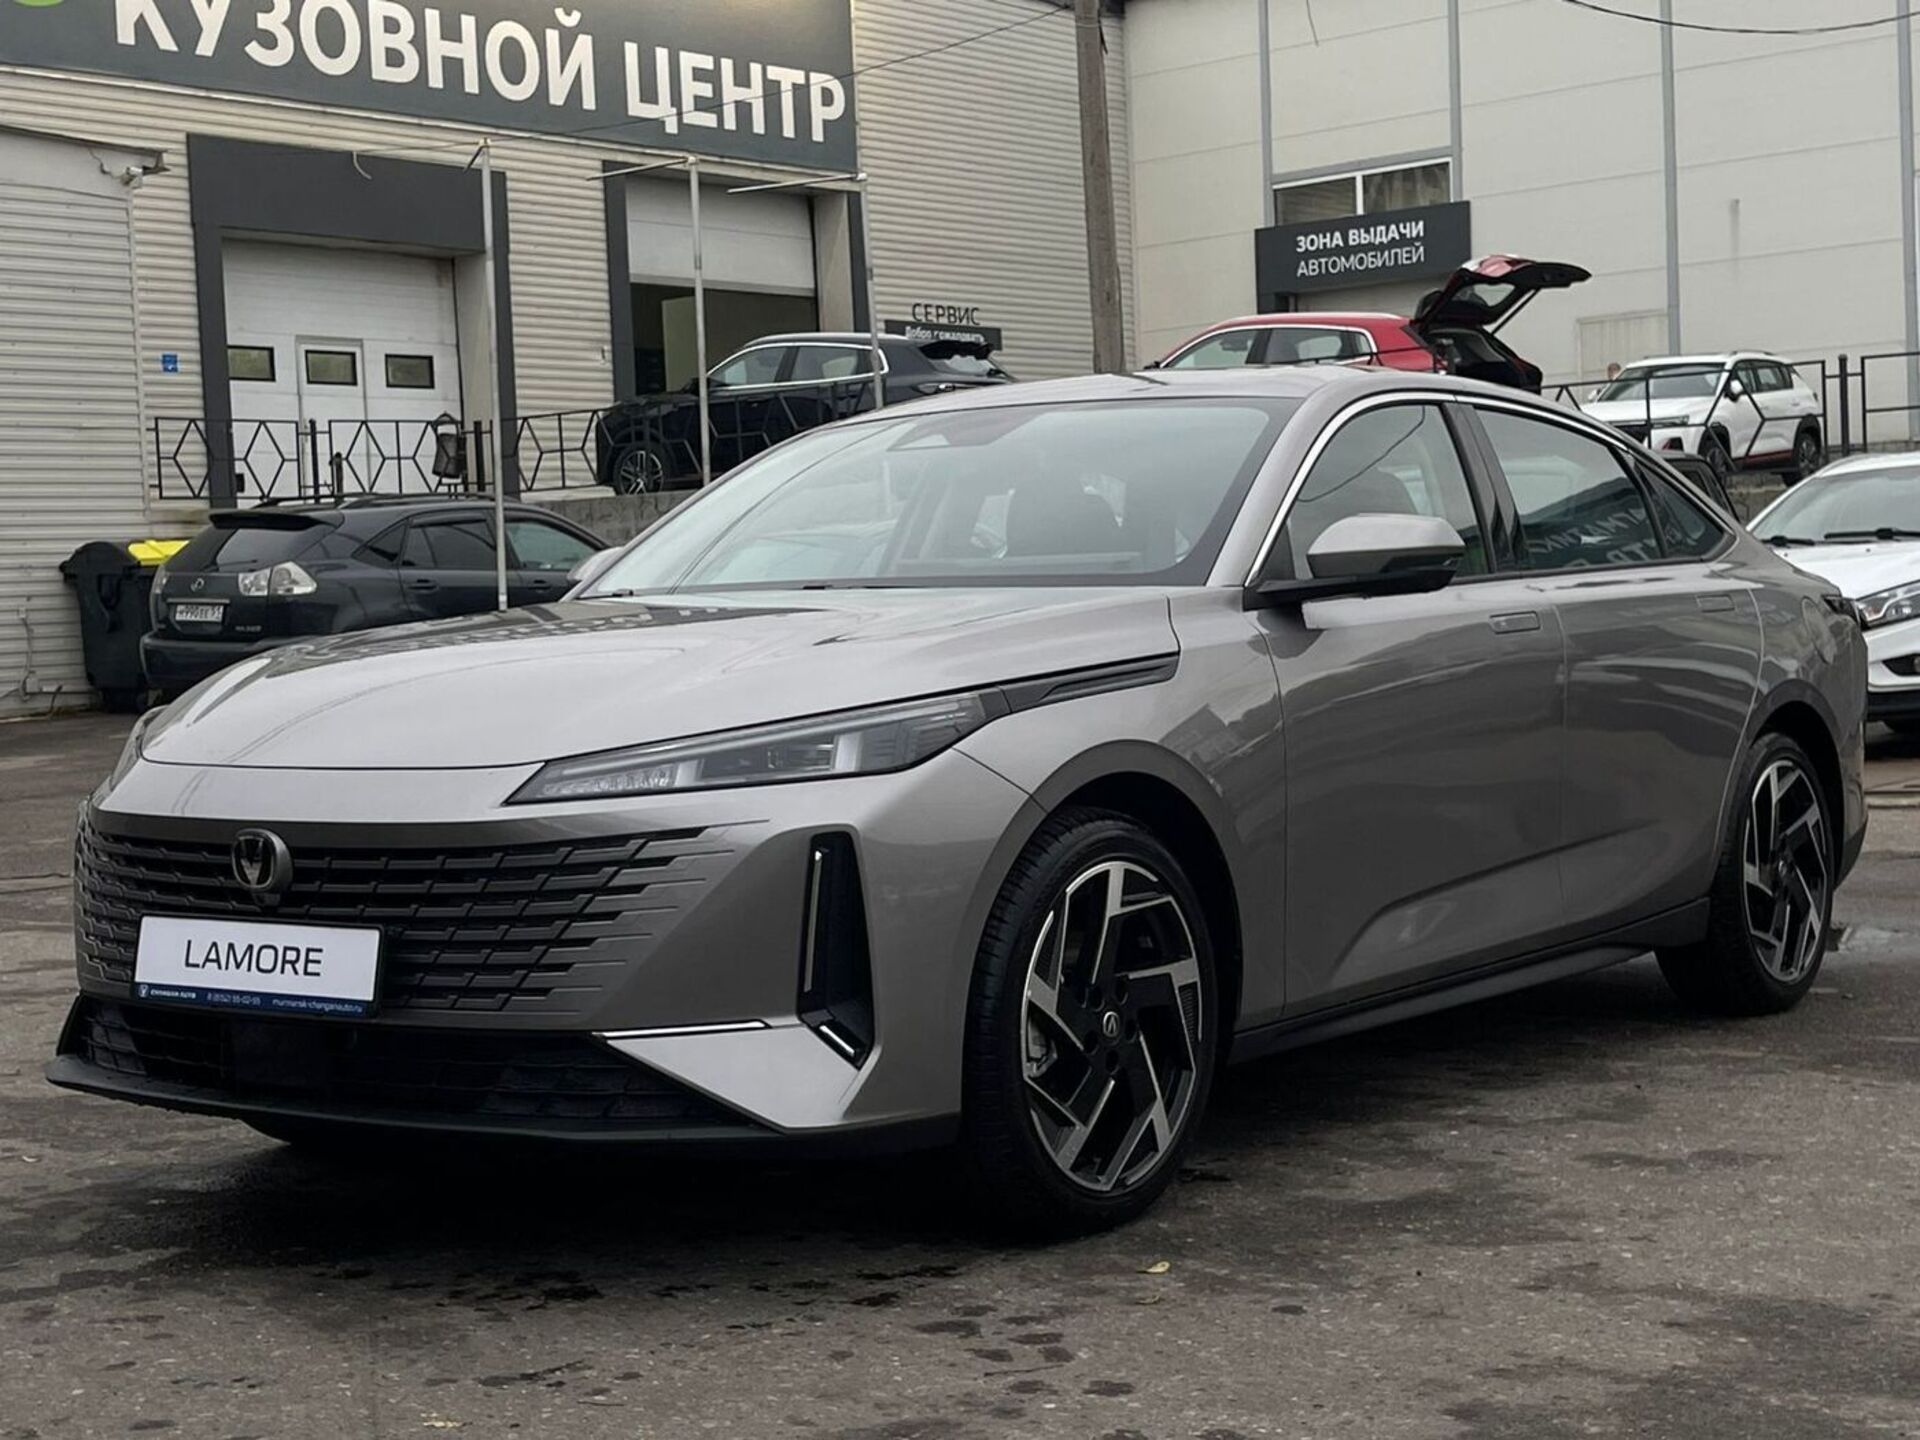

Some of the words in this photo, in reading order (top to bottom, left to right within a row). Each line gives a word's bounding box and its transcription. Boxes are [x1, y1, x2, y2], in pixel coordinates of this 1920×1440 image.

[113, 0, 597, 111] КУЗОВНОЙ
[623, 41, 846, 143] ЦЕНТР
[1296, 227, 1343, 253] ЗОНА
[1348, 220, 1424, 246] ВЫДАЧИ
[1296, 242, 1425, 277] АВТОМОБИЛЕЙ
[912, 303, 981, 325] СЕРВИС
[184, 939, 324, 977] LAMORE
